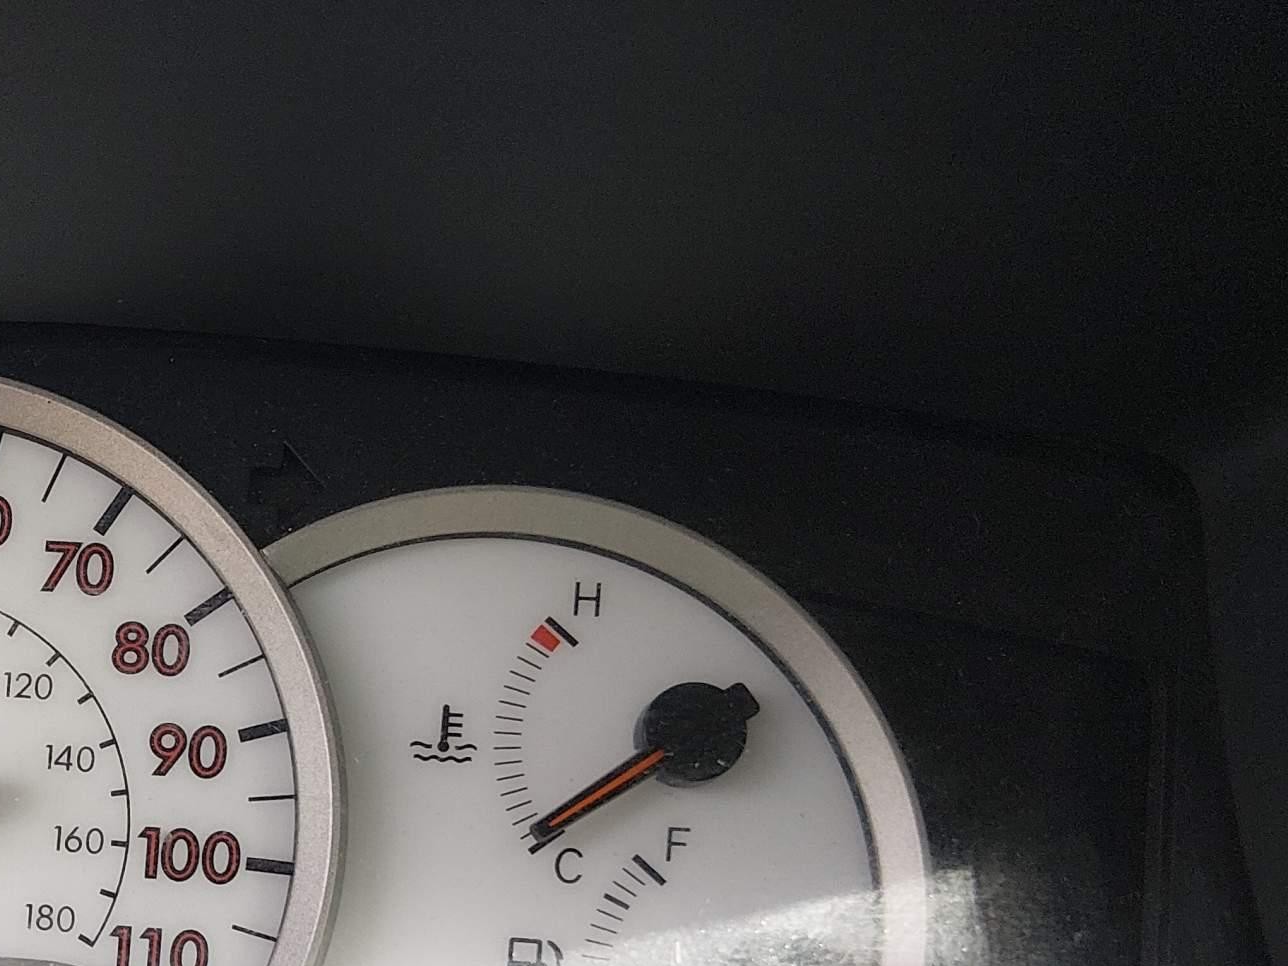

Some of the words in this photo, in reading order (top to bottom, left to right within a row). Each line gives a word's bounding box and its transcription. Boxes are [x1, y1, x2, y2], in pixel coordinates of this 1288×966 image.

[40, 540, 114, 596] 70
[573, 581, 602, 617] H
[112, 621, 191, 677] 80
[4, 672, 53, 700] 120
[46, 744, 95, 773] 140
[149, 723, 227, 779] 90
[54, 826, 105, 855] 160
[137, 826, 241, 885] 100
[665, 827, 691, 862] F
[555, 847, 583, 884] C
[25, 904, 75, 933] 180
